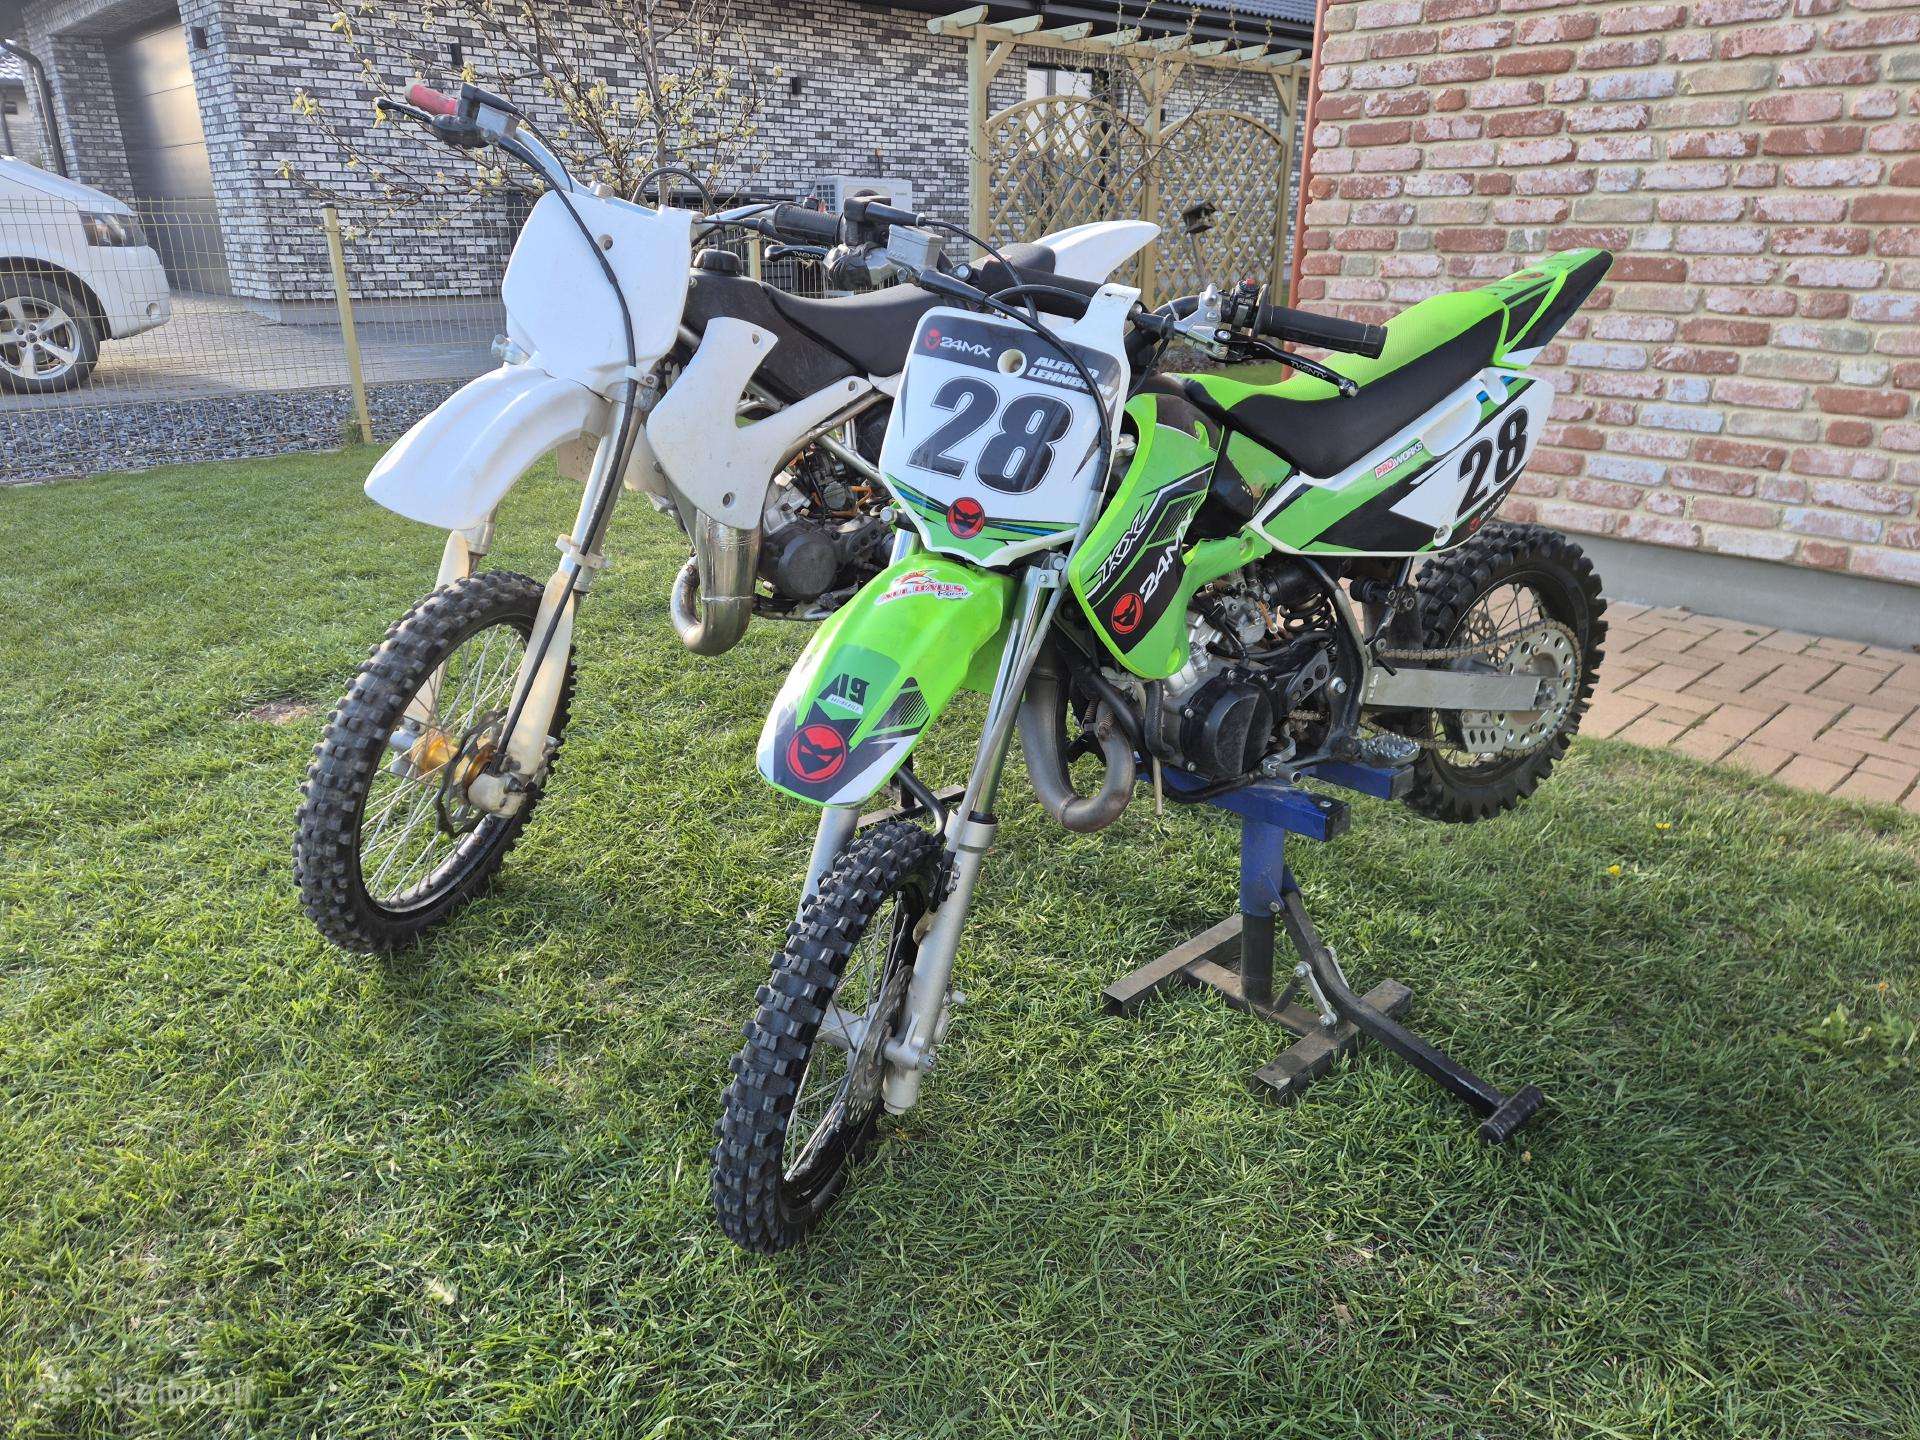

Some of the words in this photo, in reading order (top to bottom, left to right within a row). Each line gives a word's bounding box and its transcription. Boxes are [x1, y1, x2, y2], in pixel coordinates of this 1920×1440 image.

[793, 251, 823, 259] TWENTY
[940, 336, 992, 358] 24MX
[1033, 356, 1099, 379] ALFRD
[1290, 360, 1328, 379] TWENTY
[907, 377, 1073, 494] 28
[1456, 406, 1529, 520] 28
